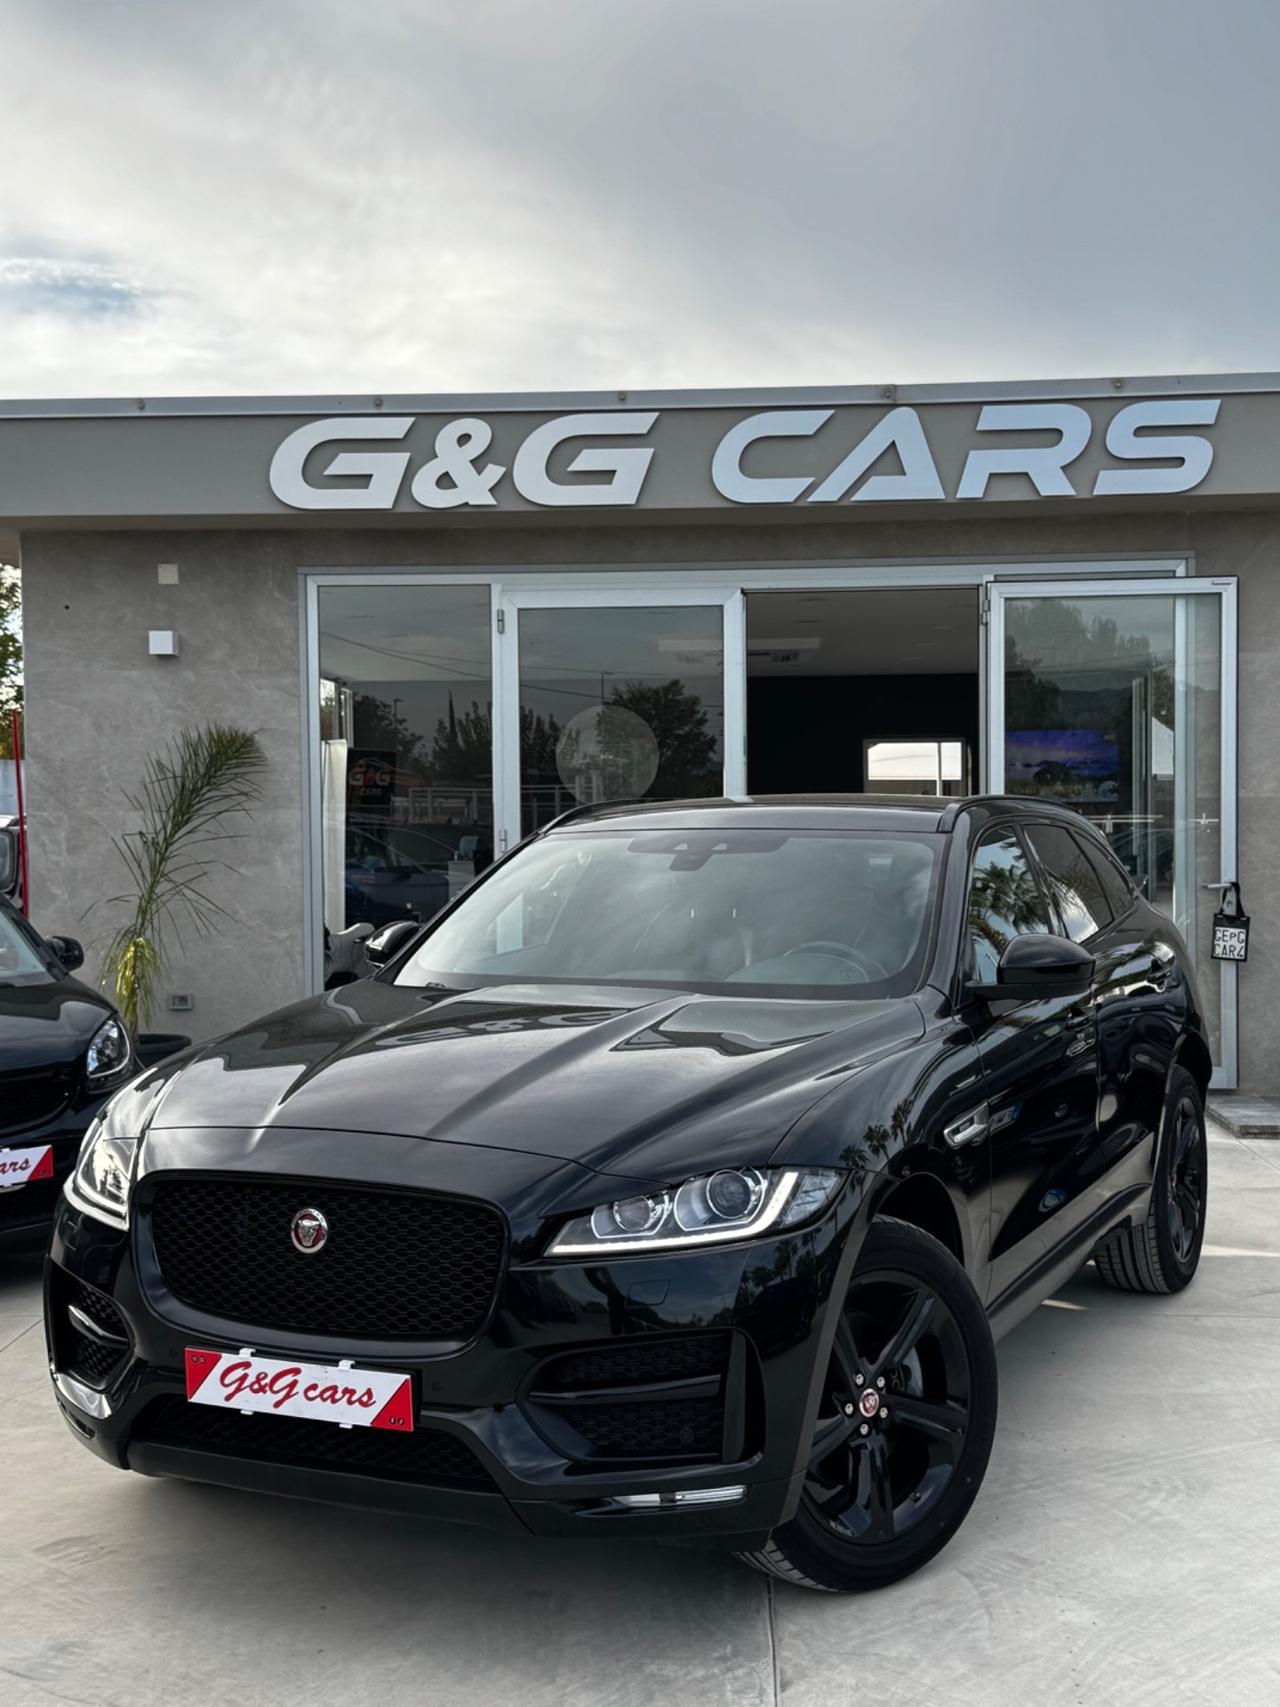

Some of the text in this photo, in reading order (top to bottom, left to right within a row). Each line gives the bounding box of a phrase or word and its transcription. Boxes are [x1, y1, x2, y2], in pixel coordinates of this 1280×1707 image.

[269, 398, 1223, 510] G&G CARS
[219, 1360, 377, 1409] G&G cars
